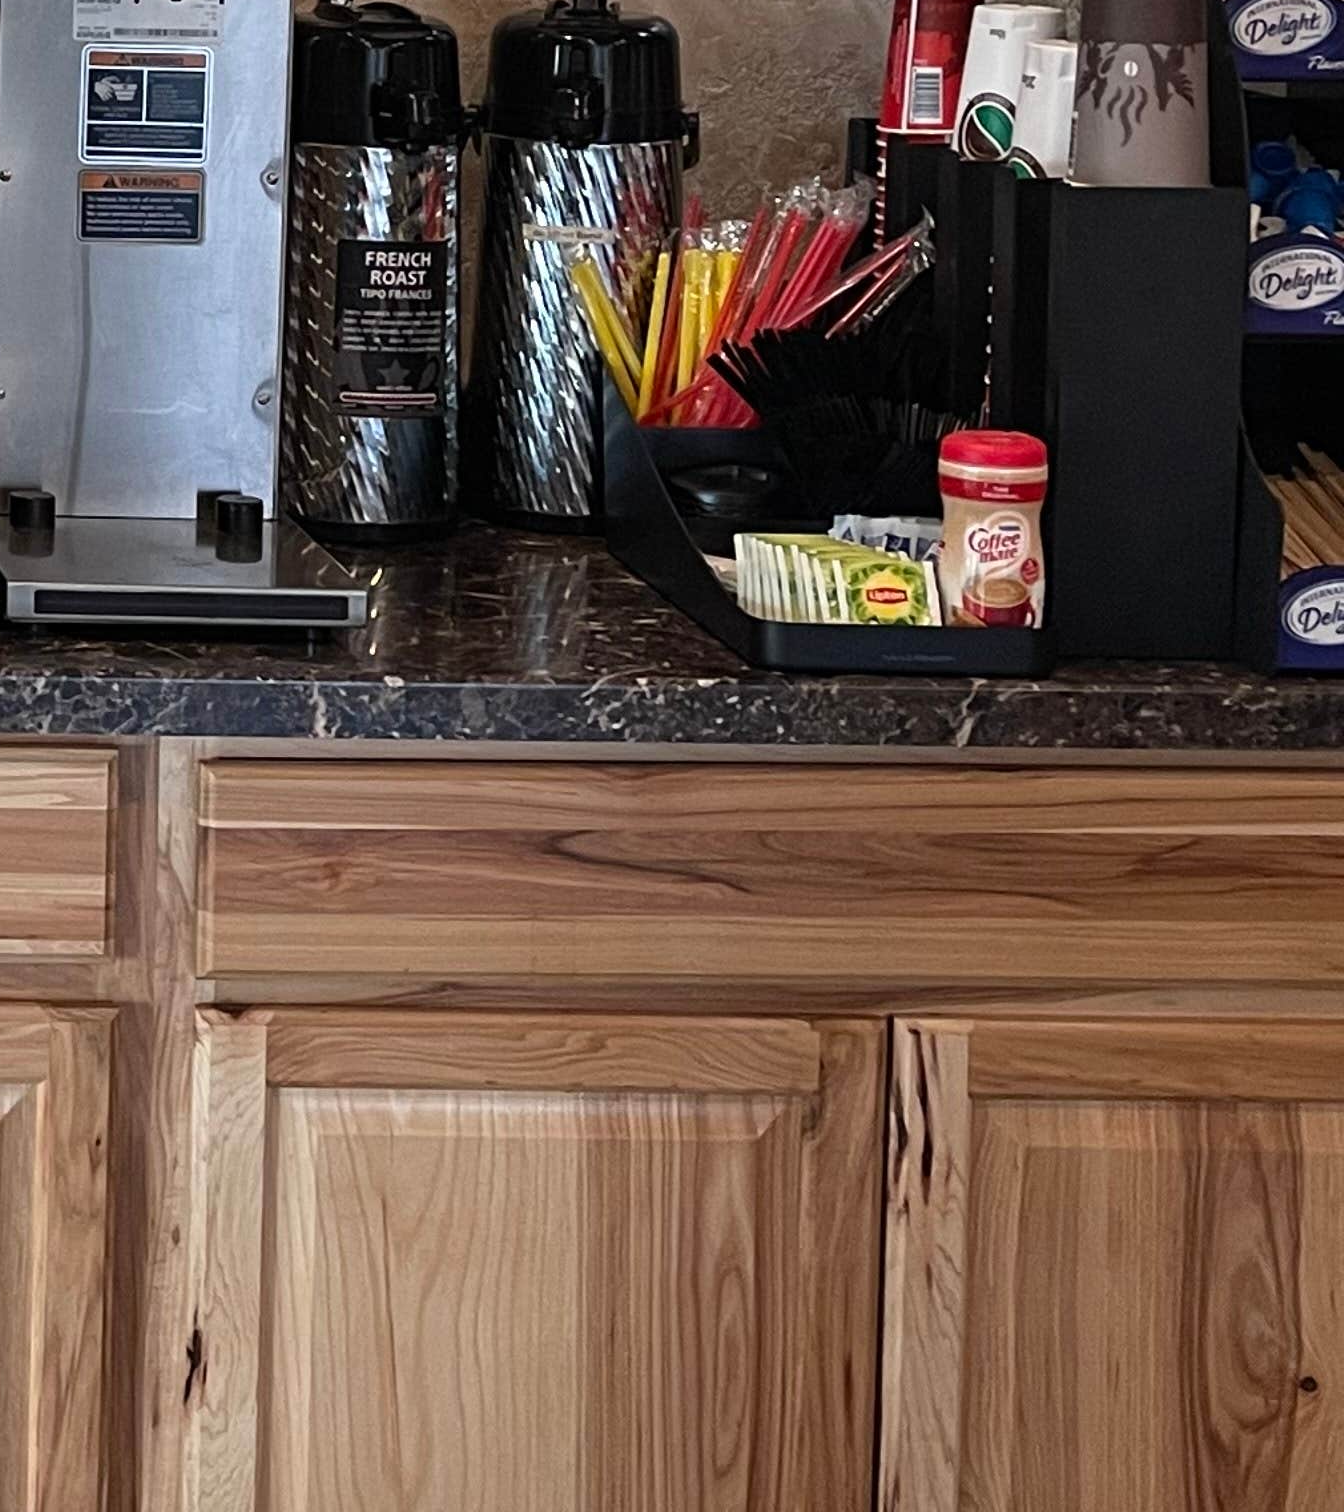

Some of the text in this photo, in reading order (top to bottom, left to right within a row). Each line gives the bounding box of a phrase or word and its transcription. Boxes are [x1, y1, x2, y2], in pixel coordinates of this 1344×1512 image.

[1244, 12, 1322, 45] Delight
[119, 175, 181, 187] WARNING
[365, 251, 432, 267] FRENCH
[370, 270, 427, 285] ROAST
[1259, 267, 1338, 300] Delight
[360, 288, 387, 299] TIPO
[968, 527, 1021, 554] Coffee
[979, 548, 1019, 563] mate
[869, 589, 906, 603] Lipton
